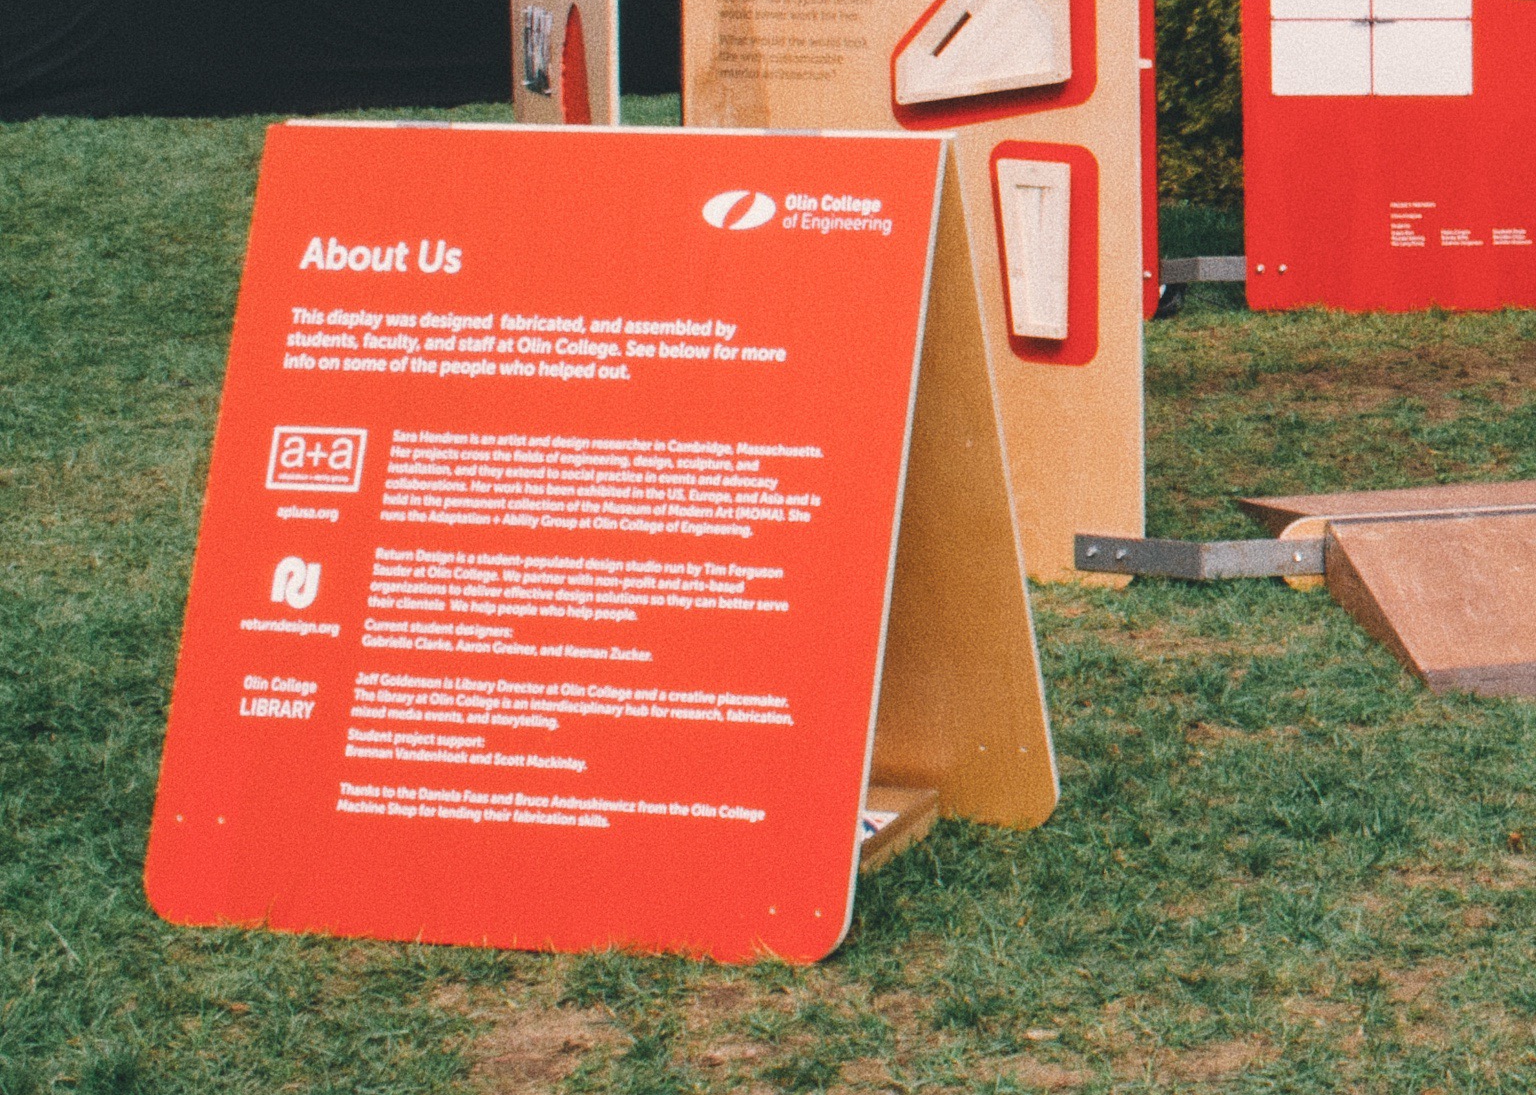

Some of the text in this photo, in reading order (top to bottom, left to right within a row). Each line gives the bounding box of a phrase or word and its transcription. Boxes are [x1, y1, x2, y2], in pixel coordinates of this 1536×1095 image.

[784, 193, 882, 216] Olin College
[782, 213, 892, 236] of Engineering
[299, 236, 462, 275] About Us
[293, 307, 736, 341] This display was designed fabricated, and assembled by
[287, 331, 787, 362] students, faculty, and staff at Olin College. See below for more
[283, 353, 629, 381] info on some of the people who helped out.
[280, 436, 354, 470] a+a
[276, 505, 339, 522] aplusa.org
[240, 618, 340, 637] returndesign.org
[364, 618, 409, 633] Current
[409, 622, 455, 635] student
[456, 639, 492, 653] Aaron
[540, 645, 565, 657] and
[243, 675, 318, 696] Olin College
[356, 672, 380, 685] Jeff
[443, 677, 454, 689] is
[454, 678, 496, 694] Library
[496, 679, 545, 694] Director
[546, 683, 560, 695] at
[560, 683, 586, 697] Olin
[586, 684, 633, 702] College
[633, 688, 659, 701] and
[656, 690, 667, 702] a
[667, 691, 716, 704] creative
[239, 698, 315, 720] LIBRARY
[387, 708, 424, 721] media
[466, 712, 491, 724] and
[347, 728, 394, 743] Student
[392, 732, 436, 747] project
[468, 752, 493, 765] and
[493, 752, 526, 767] Scott
[336, 799, 387, 814] Machine
[387, 802, 418, 818] Shop
[415, 804, 437, 817] for
[437, 805, 483, 823] lending
[482, 808, 512, 822] their
[512, 809, 577, 825] fabrication
[341, 782, 381, 797] Thanks
[379, 786, 396, 798] to
[395, 787, 418, 800] the
[417, 787, 463, 803] Daniela
[489, 793, 515, 805] and
[513, 792, 550, 808] Bruce
[637, 800, 668, 814] from
[668, 802, 690, 816] the
[690, 803, 718, 817] Olin
[718, 805, 765, 823] College
